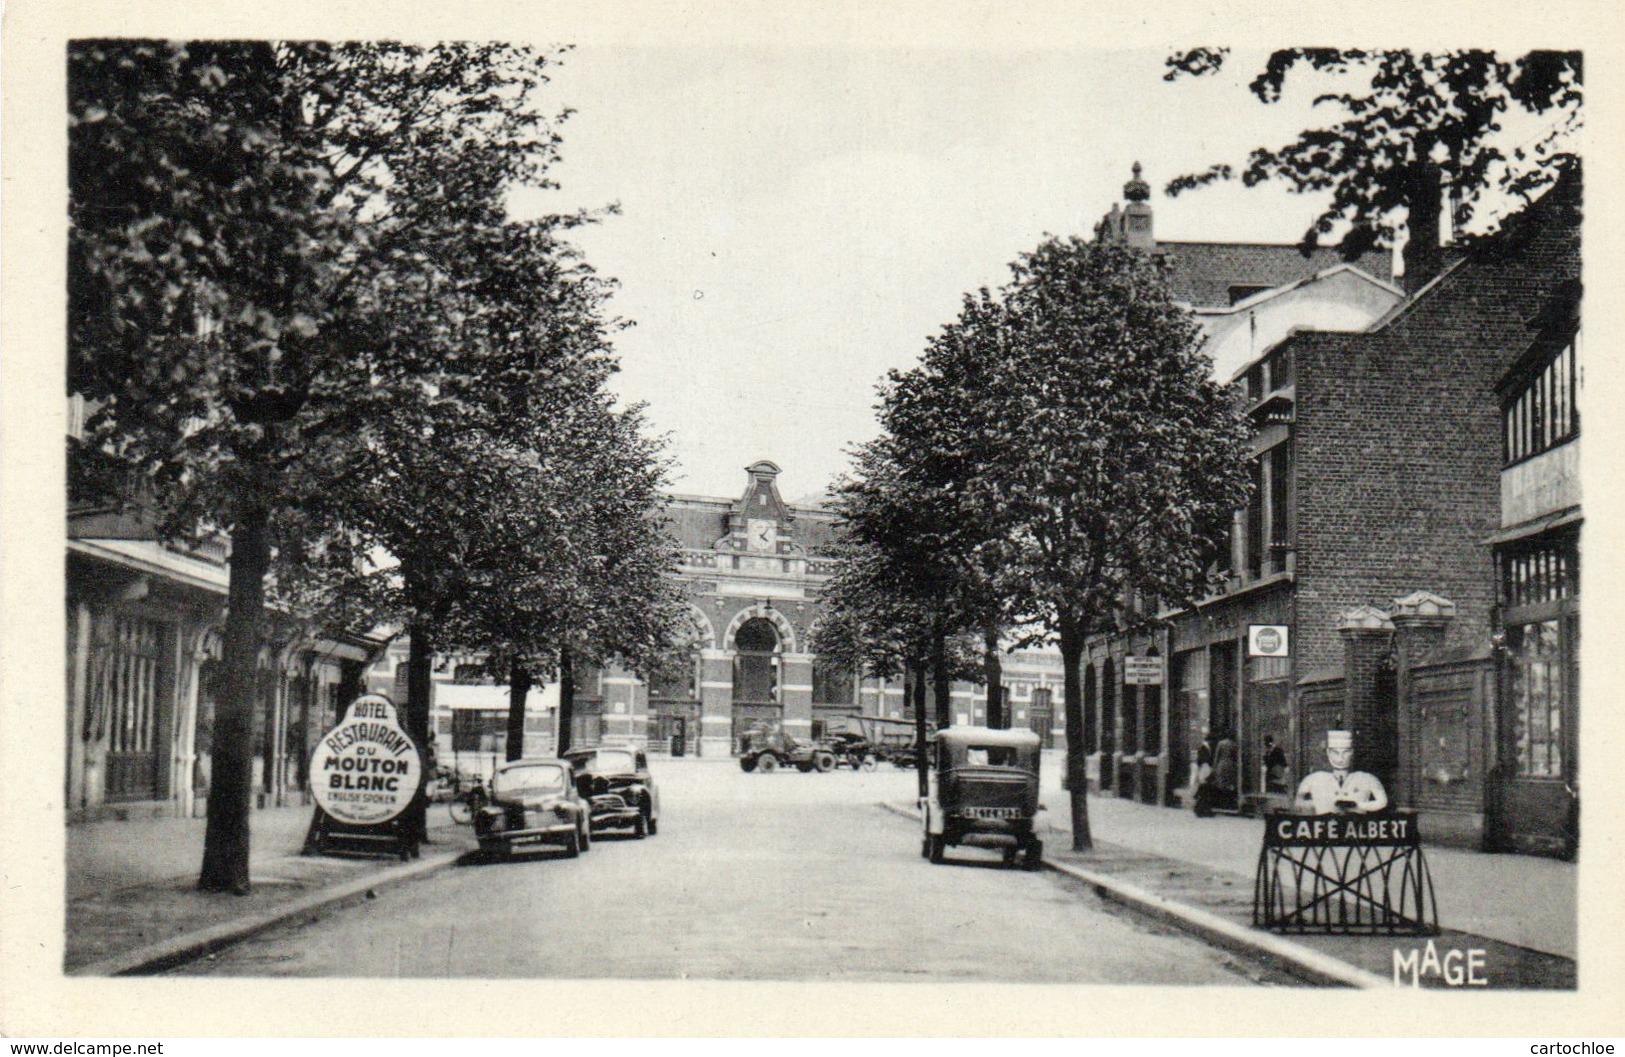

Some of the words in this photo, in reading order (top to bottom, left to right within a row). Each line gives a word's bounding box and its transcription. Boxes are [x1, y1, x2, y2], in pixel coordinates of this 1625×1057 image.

[325, 722, 412, 757] RESTAURANT
[356, 746, 377, 756] DU
[323, 756, 409, 775] MOUTON
[328, 773, 399, 792] BLANC
[327, 791, 361, 802] ENGLISH
[362, 793, 397, 805] SPOKEN
[1278, 819, 1339, 839] CAFÉ
[1344, 820, 1408, 839] ALBERT
